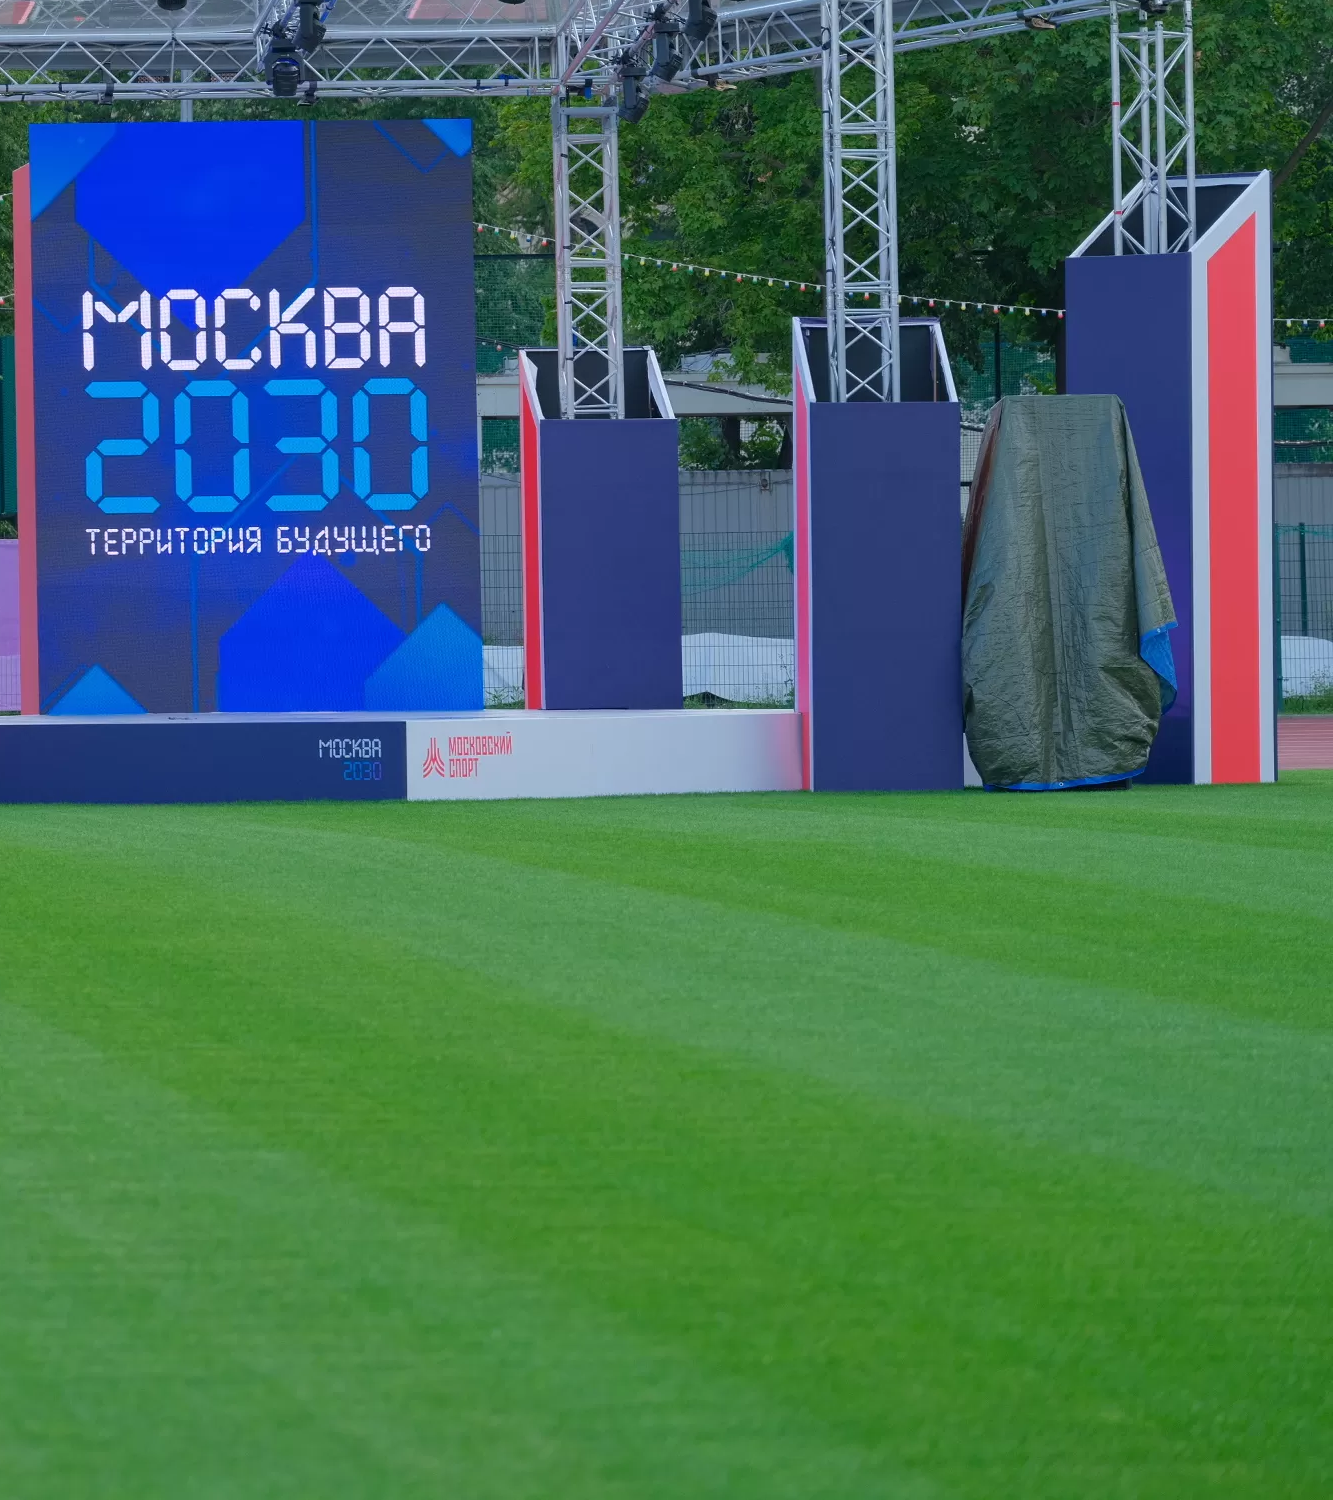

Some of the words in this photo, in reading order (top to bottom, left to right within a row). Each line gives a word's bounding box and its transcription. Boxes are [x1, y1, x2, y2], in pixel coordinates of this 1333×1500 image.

[82, 286, 426, 371] МОСКВА
[84, 378, 429, 514] 2030
[85, 527, 262, 555] ТЕРРИТОРИЯ
[276, 524, 431, 556] БУДУЩЕГО
[318, 738, 382, 759] МОСКВА
[448, 731, 513, 756] МОСКОВСКИЙ
[343, 761, 382, 781] 2030
[449, 757, 479, 778] СПОРТ
